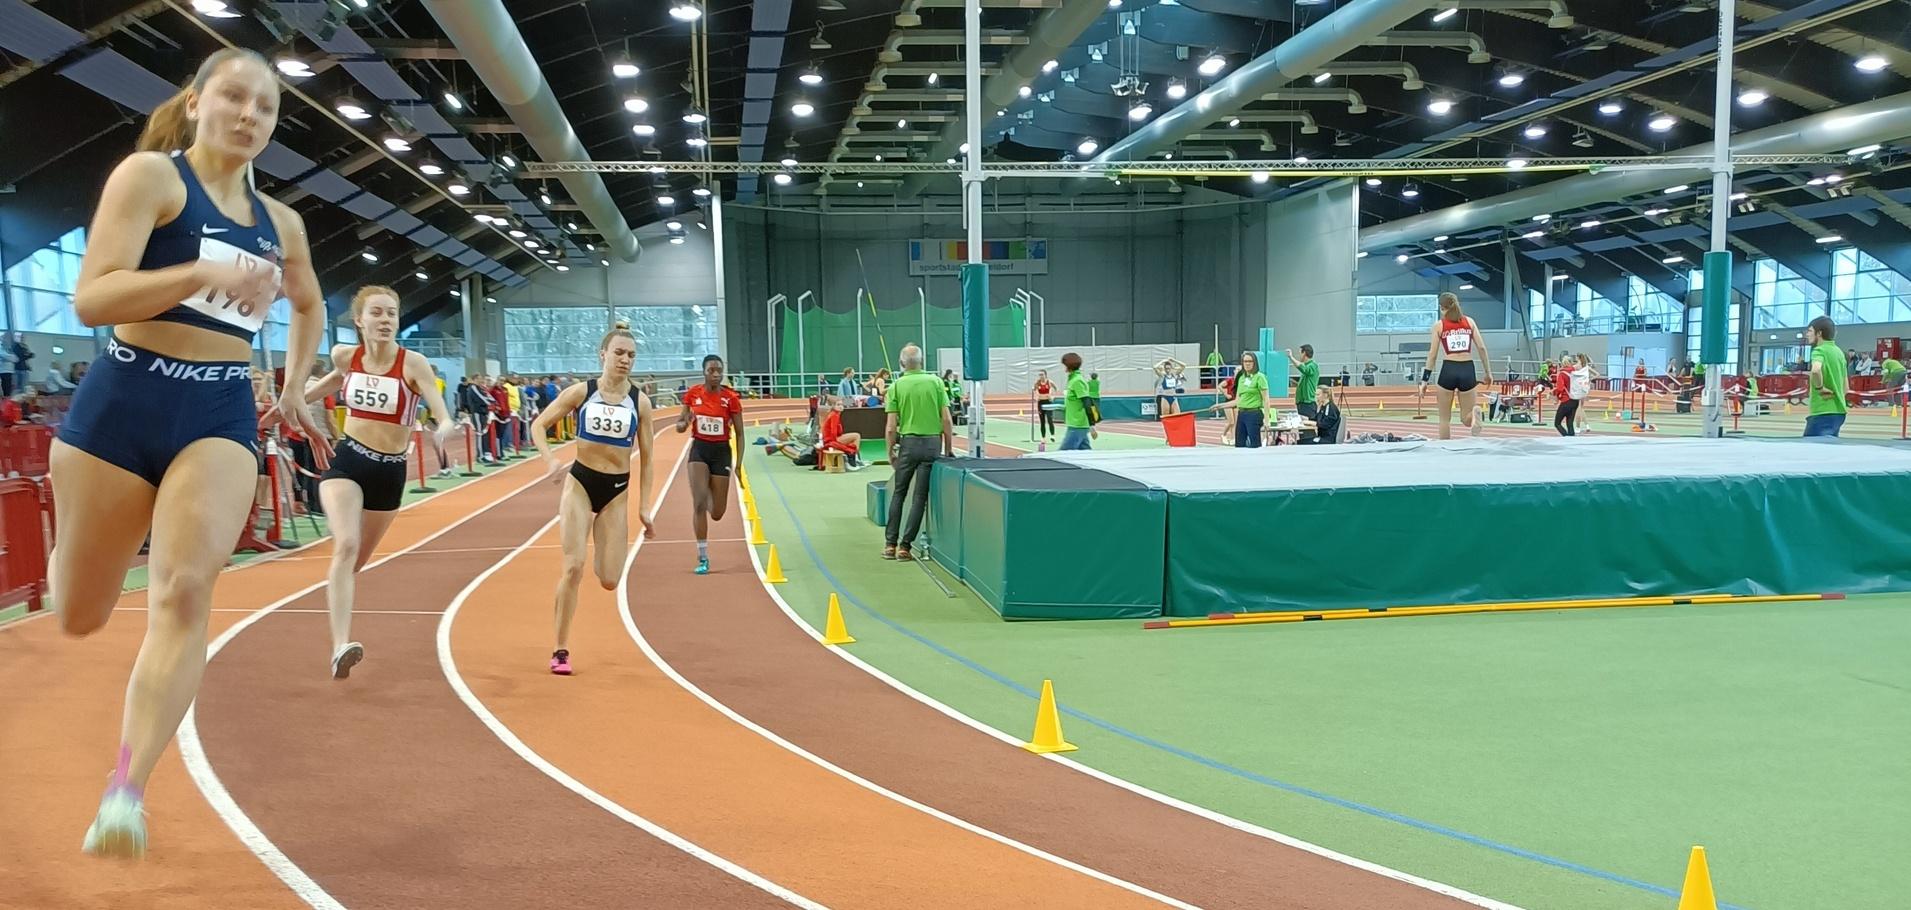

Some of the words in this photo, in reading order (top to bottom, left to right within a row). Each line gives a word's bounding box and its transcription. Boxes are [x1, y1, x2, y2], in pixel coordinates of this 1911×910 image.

[1450, 340, 1467, 349] 290
[148, 357, 224, 382] NIKE
[354, 388, 389, 409] 559
[592, 416, 623, 434] 333
[701, 423, 720, 433] 418
[347, 440, 383, 462] NIKE
